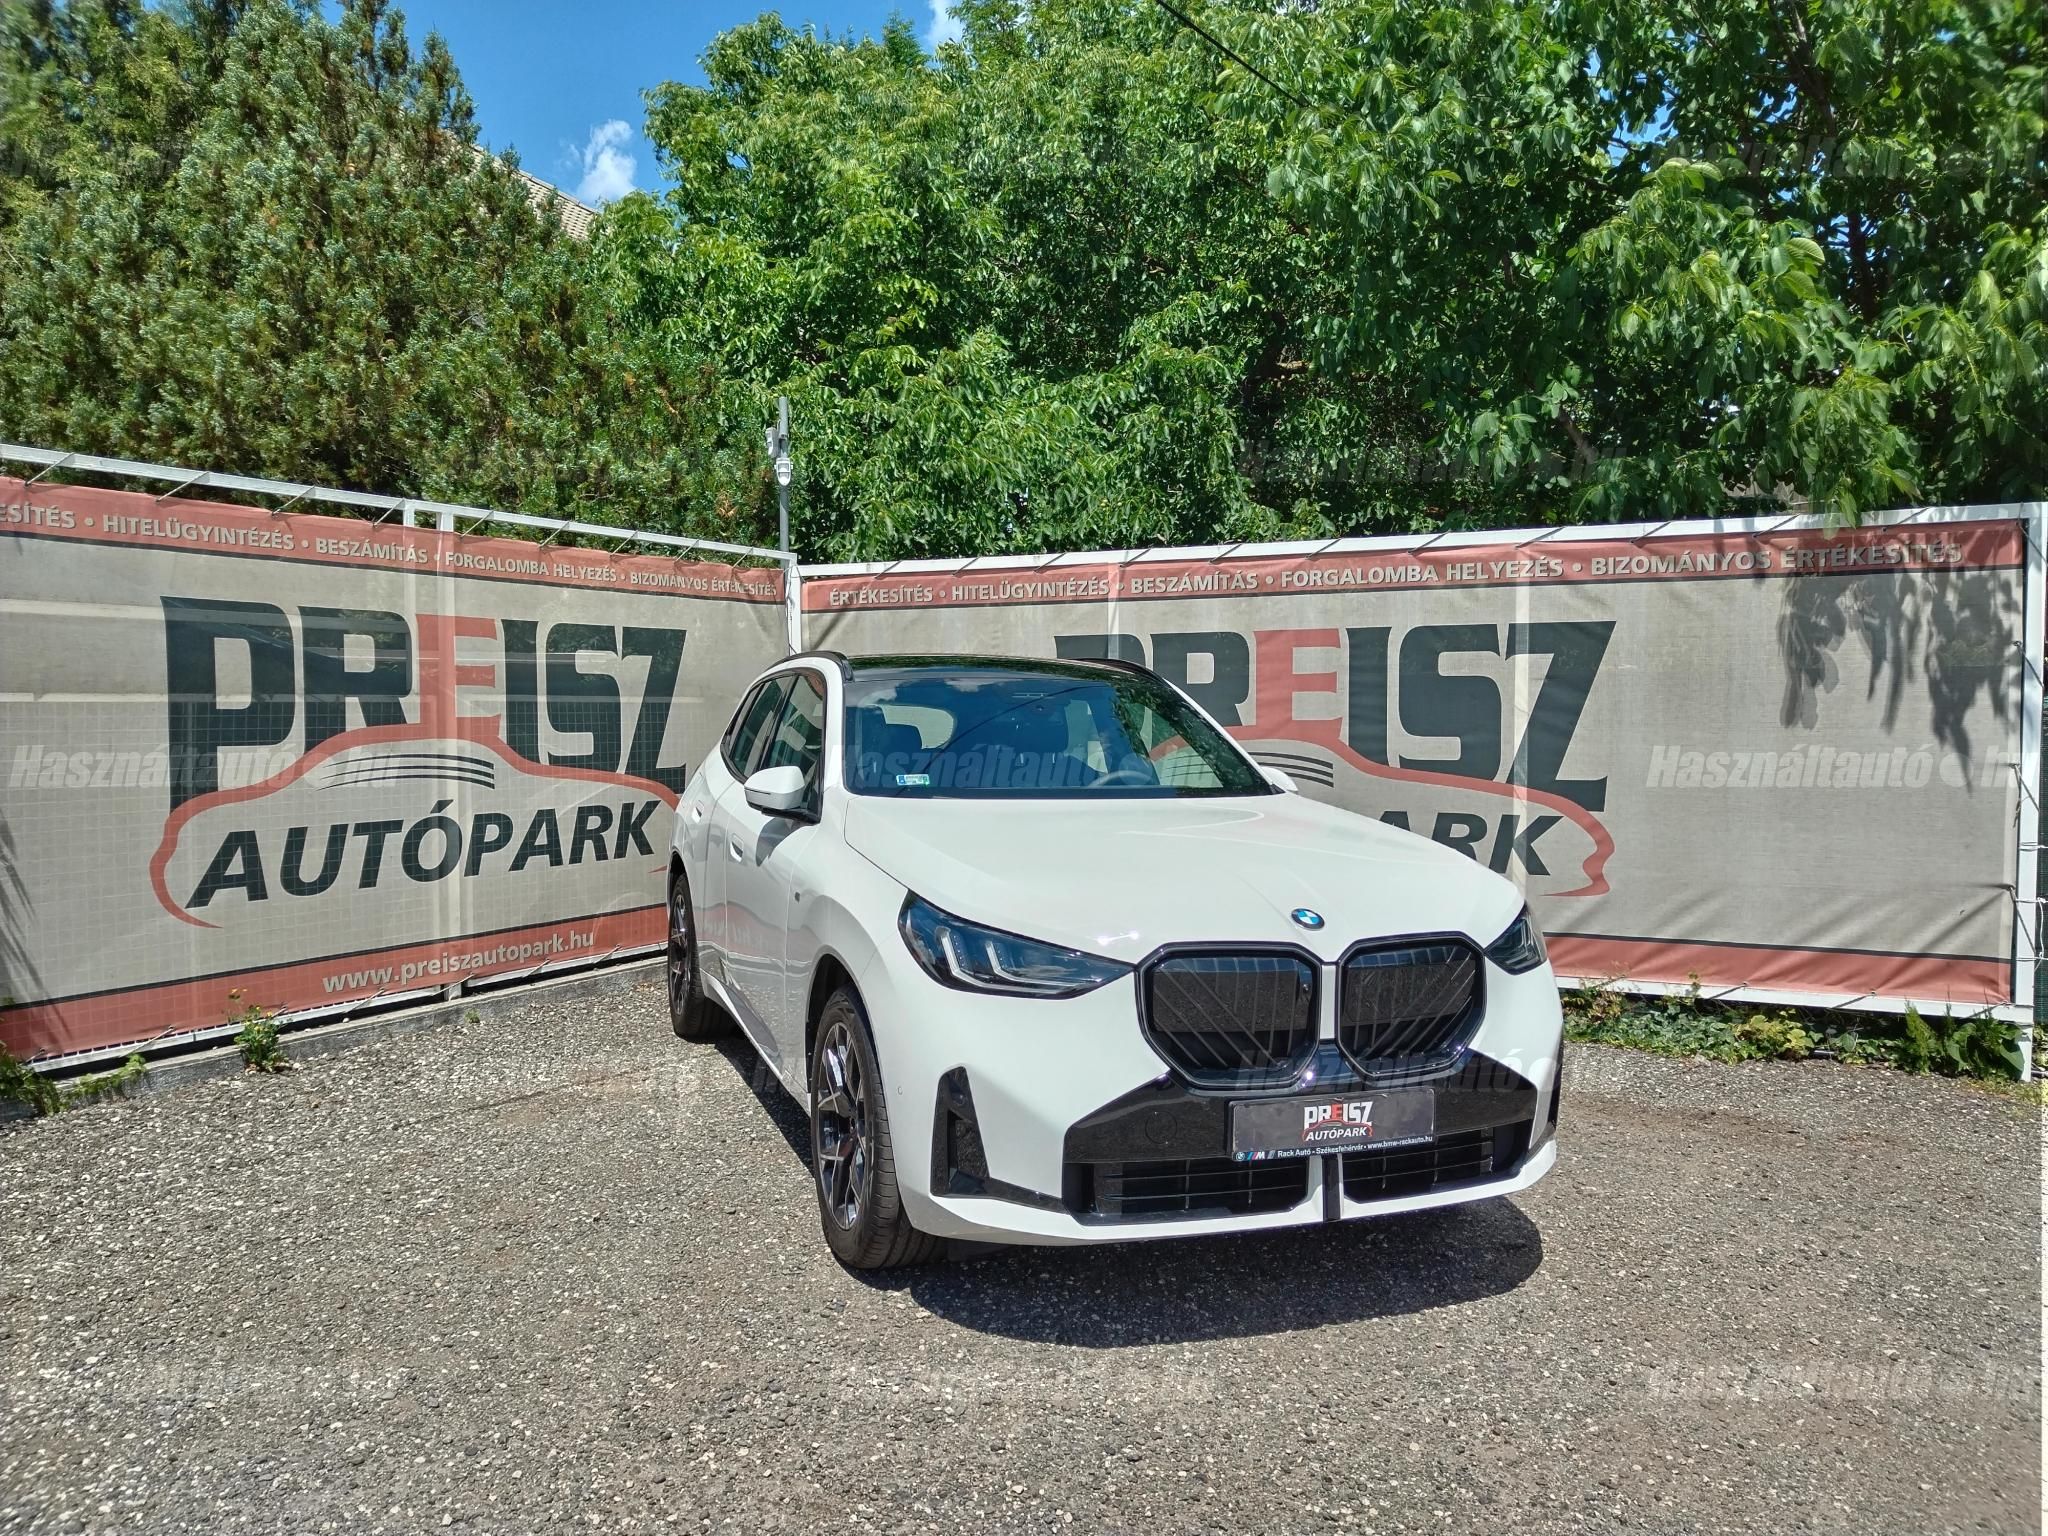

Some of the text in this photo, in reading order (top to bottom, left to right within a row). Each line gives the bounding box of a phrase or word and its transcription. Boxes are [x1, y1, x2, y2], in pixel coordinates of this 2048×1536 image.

[103, 514, 295, 551] HITELÜGYINTÉZÉS
[315, 537, 428, 563] BESZÁMÍTÁS
[446, 551, 549, 576] FORGALOMBA
[553, 563, 617, 583] HELYEZÉS
[630, 571, 708, 591] BIZOMÁNYOS
[829, 541, 1962, 607] ÉRTÉKESÍTÉS HITELÜGYINTÉZÉS BESZÁMÍTÁS FORGALOMBA HELYEZÉS BIZOMÁNYOS ÉRTÉKESÍTÉS
[160, 596, 688, 814] PREISZ
[1054, 621, 1616, 812] REISZ
[184, 800, 662, 909] AUTÓPARK
[323, 930, 594, 993] www.preiszautopark.hu
[1304, 1101, 1373, 1130] PREISZ
[1305, 1127, 1367, 1141] AUTÓPARK
[1277, 1150, 1294, 1158] Rack
[1295, 1148, 1311, 1157] Autó
[1316, 1144, 1364, 1154] Székesfehérvár
